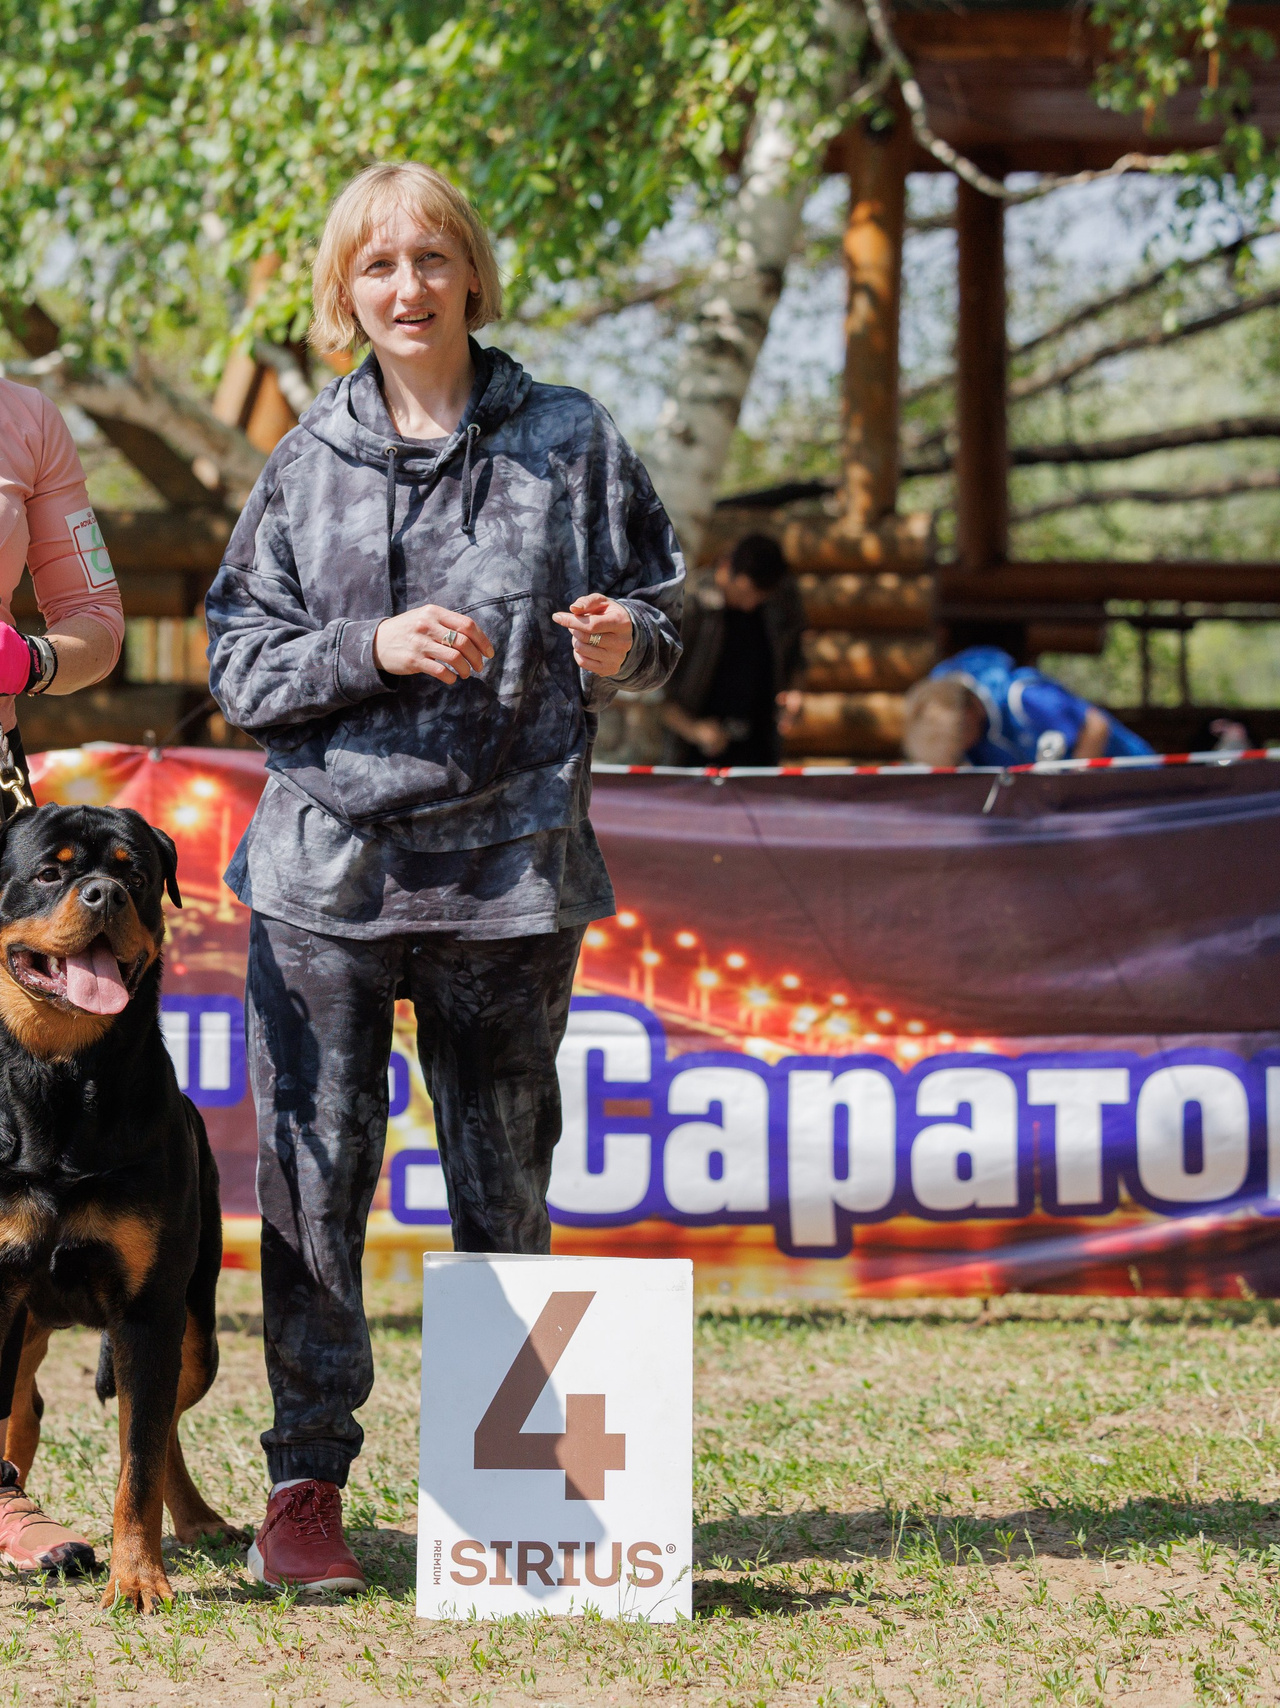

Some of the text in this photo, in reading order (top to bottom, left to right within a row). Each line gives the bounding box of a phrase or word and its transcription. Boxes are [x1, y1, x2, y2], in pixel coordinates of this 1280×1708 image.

[547, 1009, 1280, 1246] Сарато
[474, 1291, 626, 1501] 4
[433, 1540, 442, 1585] PREMIUM
